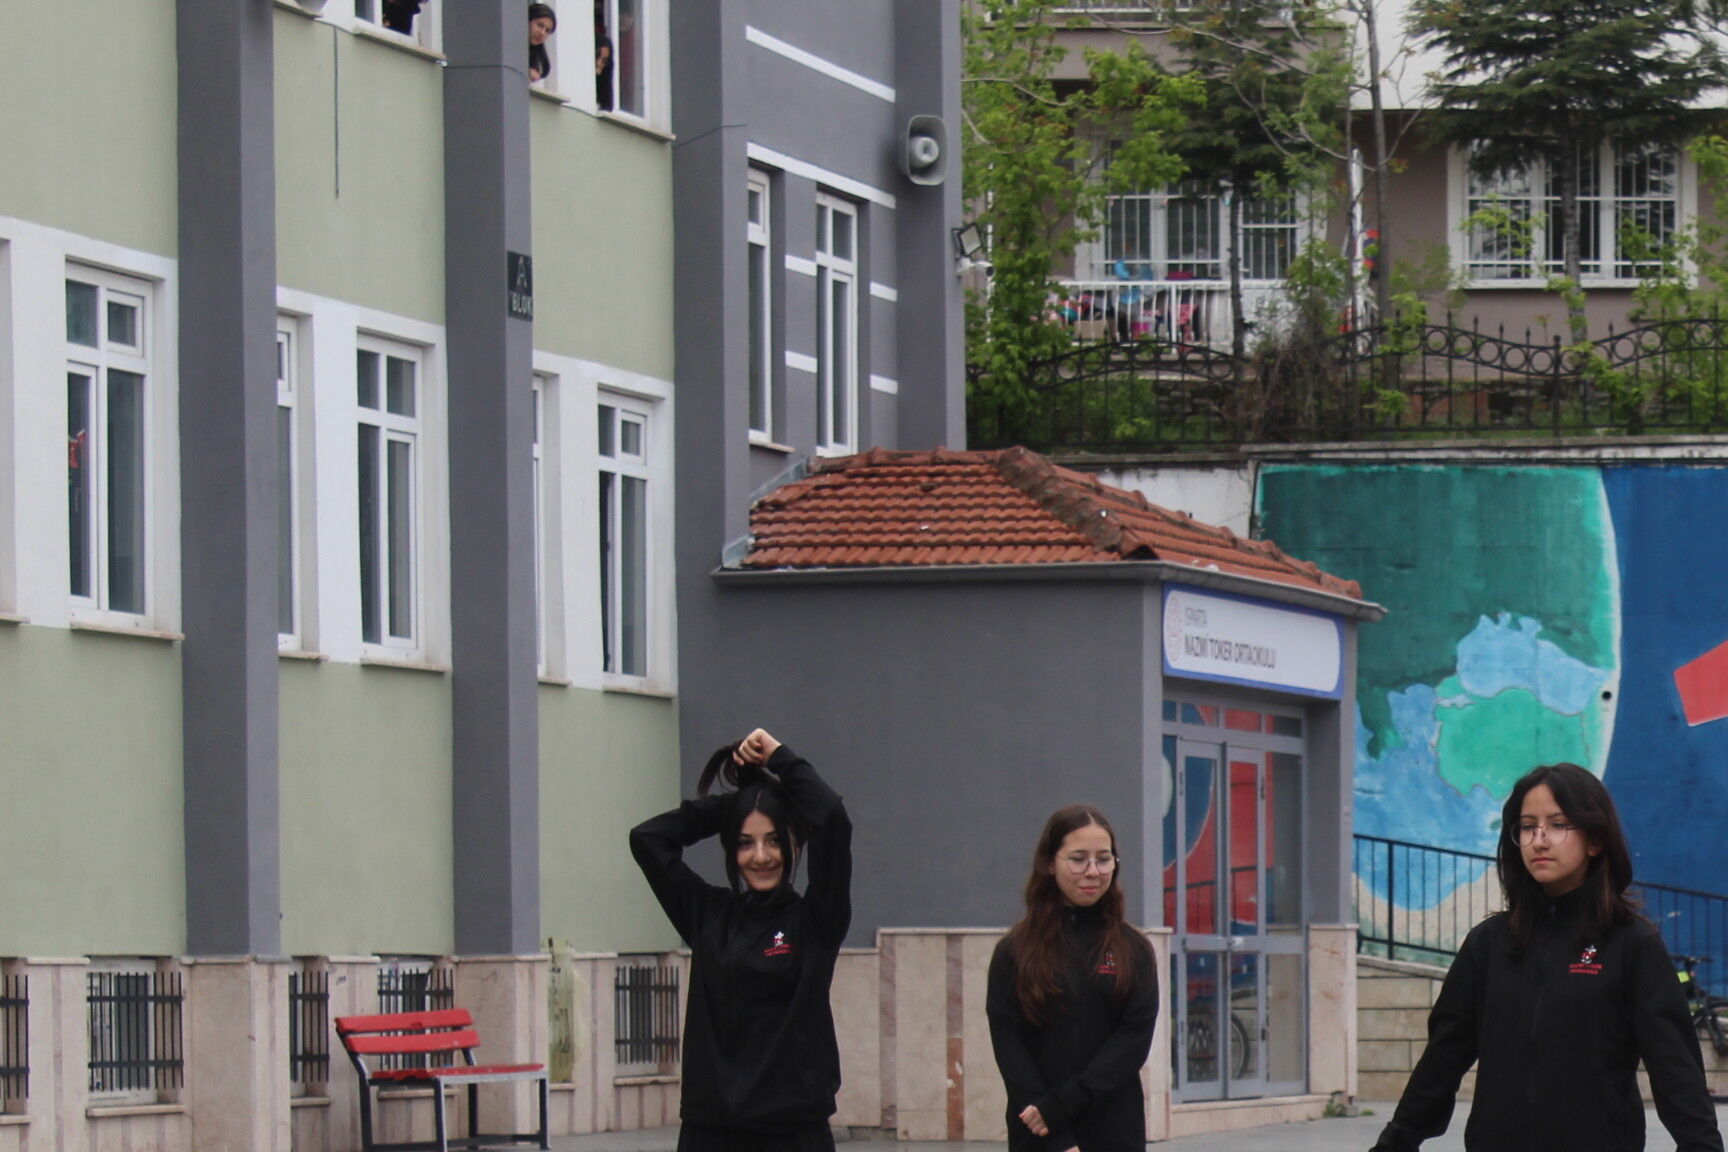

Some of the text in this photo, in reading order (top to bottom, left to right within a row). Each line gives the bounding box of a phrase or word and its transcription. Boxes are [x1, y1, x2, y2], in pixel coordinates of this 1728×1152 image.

[515, 255, 528, 288] A
[1184, 633, 1277, 669] NAZMİ TOKER ORTAOKULU
